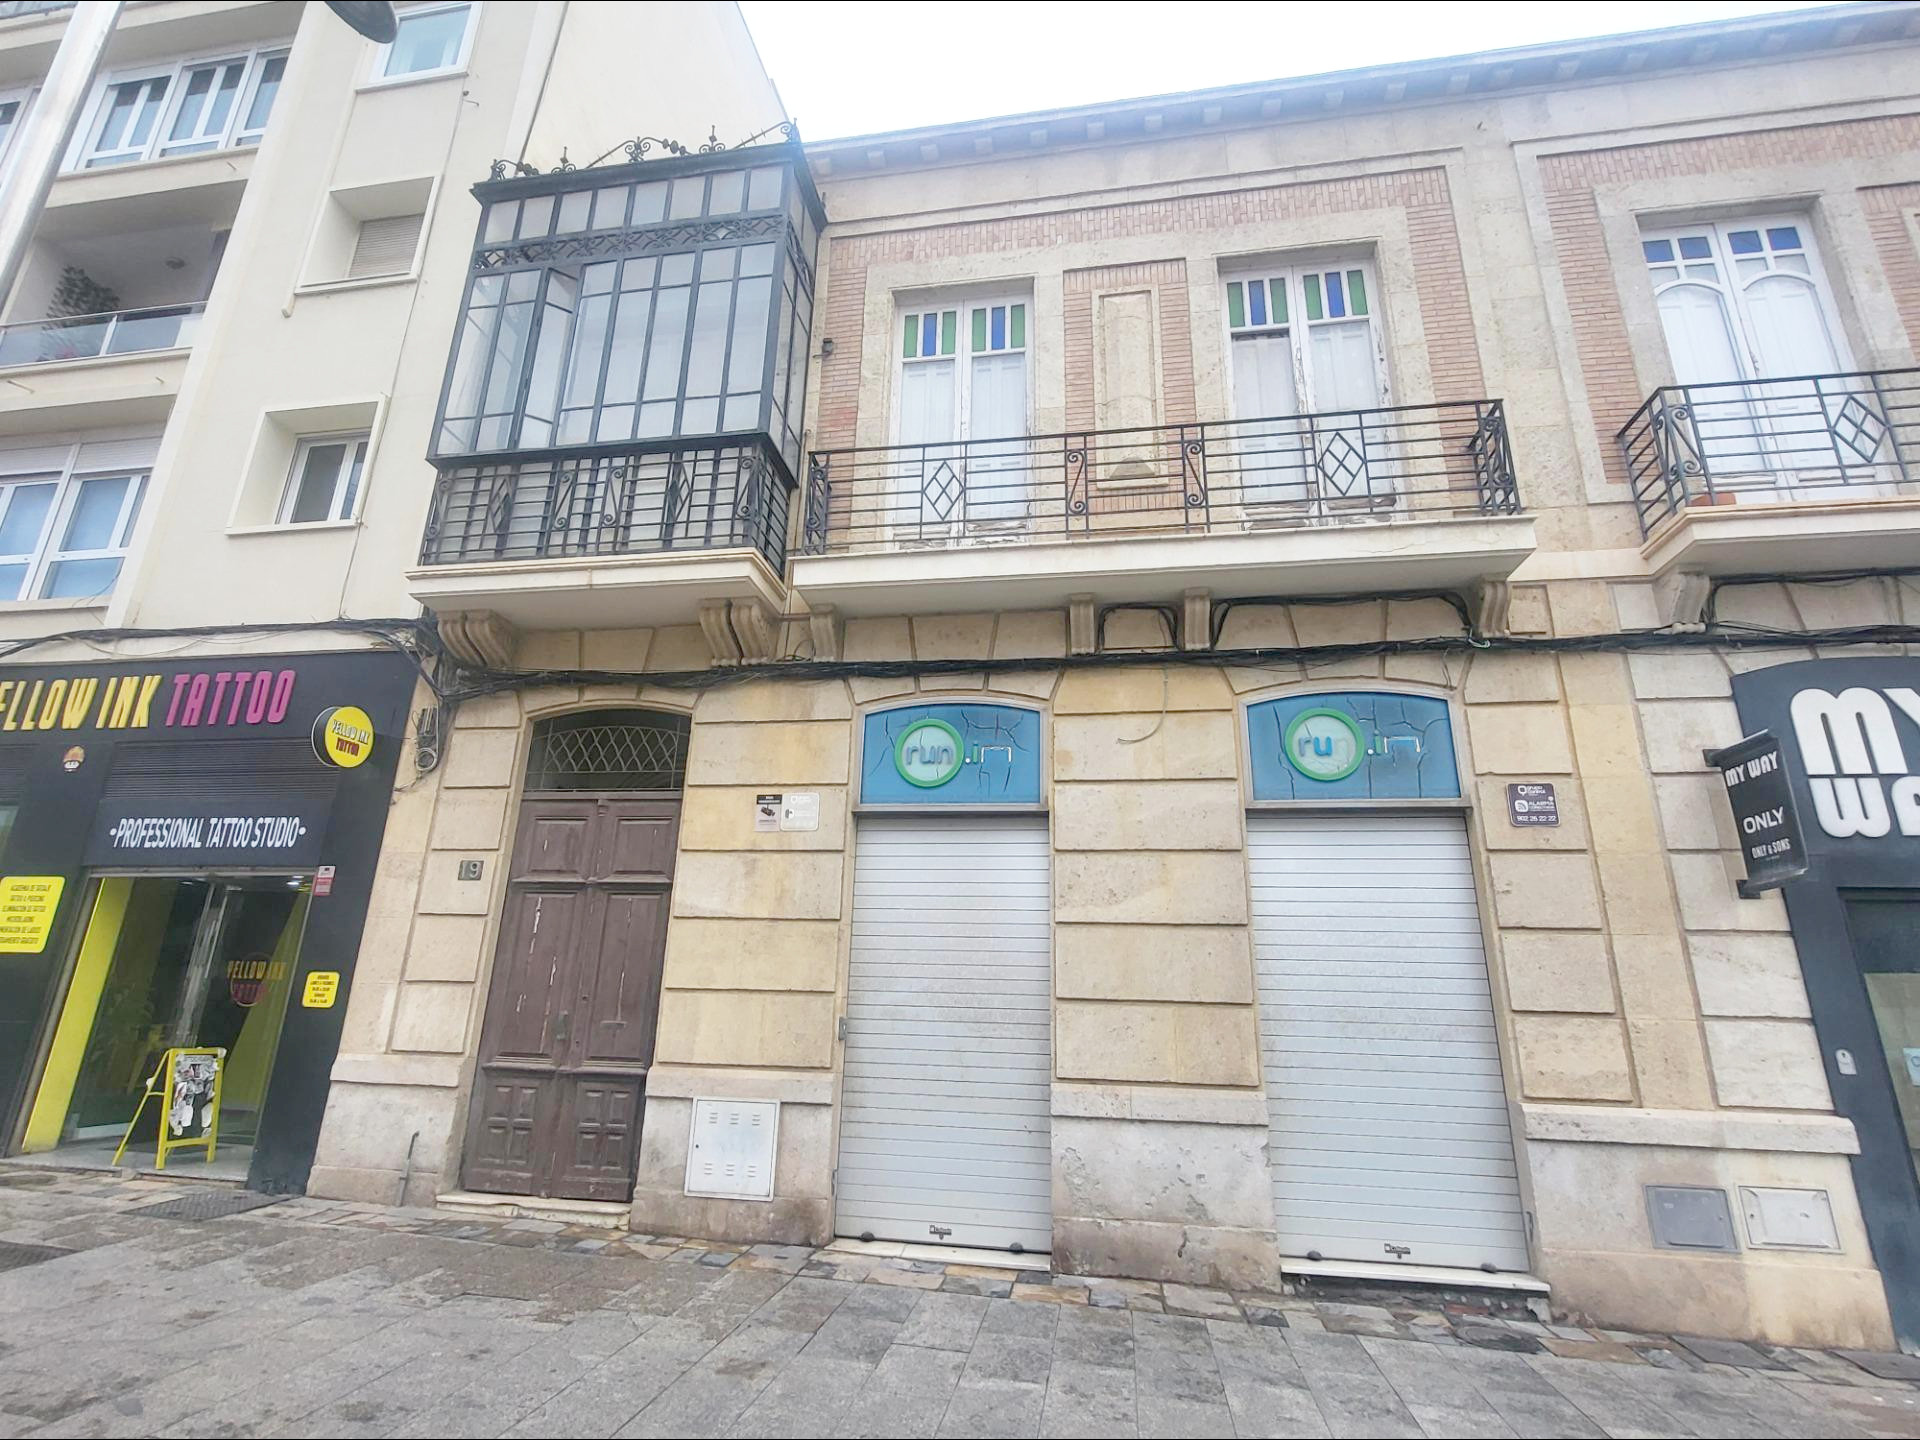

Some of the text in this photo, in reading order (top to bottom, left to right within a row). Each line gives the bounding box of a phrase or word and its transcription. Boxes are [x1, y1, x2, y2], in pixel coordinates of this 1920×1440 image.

[95, 674, 163, 729] INK
[165, 670, 297, 728] TATTOO
[332, 719, 370, 745] YELLOW INK
[336, 737, 360, 757] TATTOO
[1725, 751, 1778, 787] MY WAY
[114, 817, 301, 849] PROFESSIONAL TATTOO STUDIO
[1743, 806, 1783, 834] ONLY
[1752, 844, 1767, 858] ONLY
[1773, 838, 1791, 853] SONS
